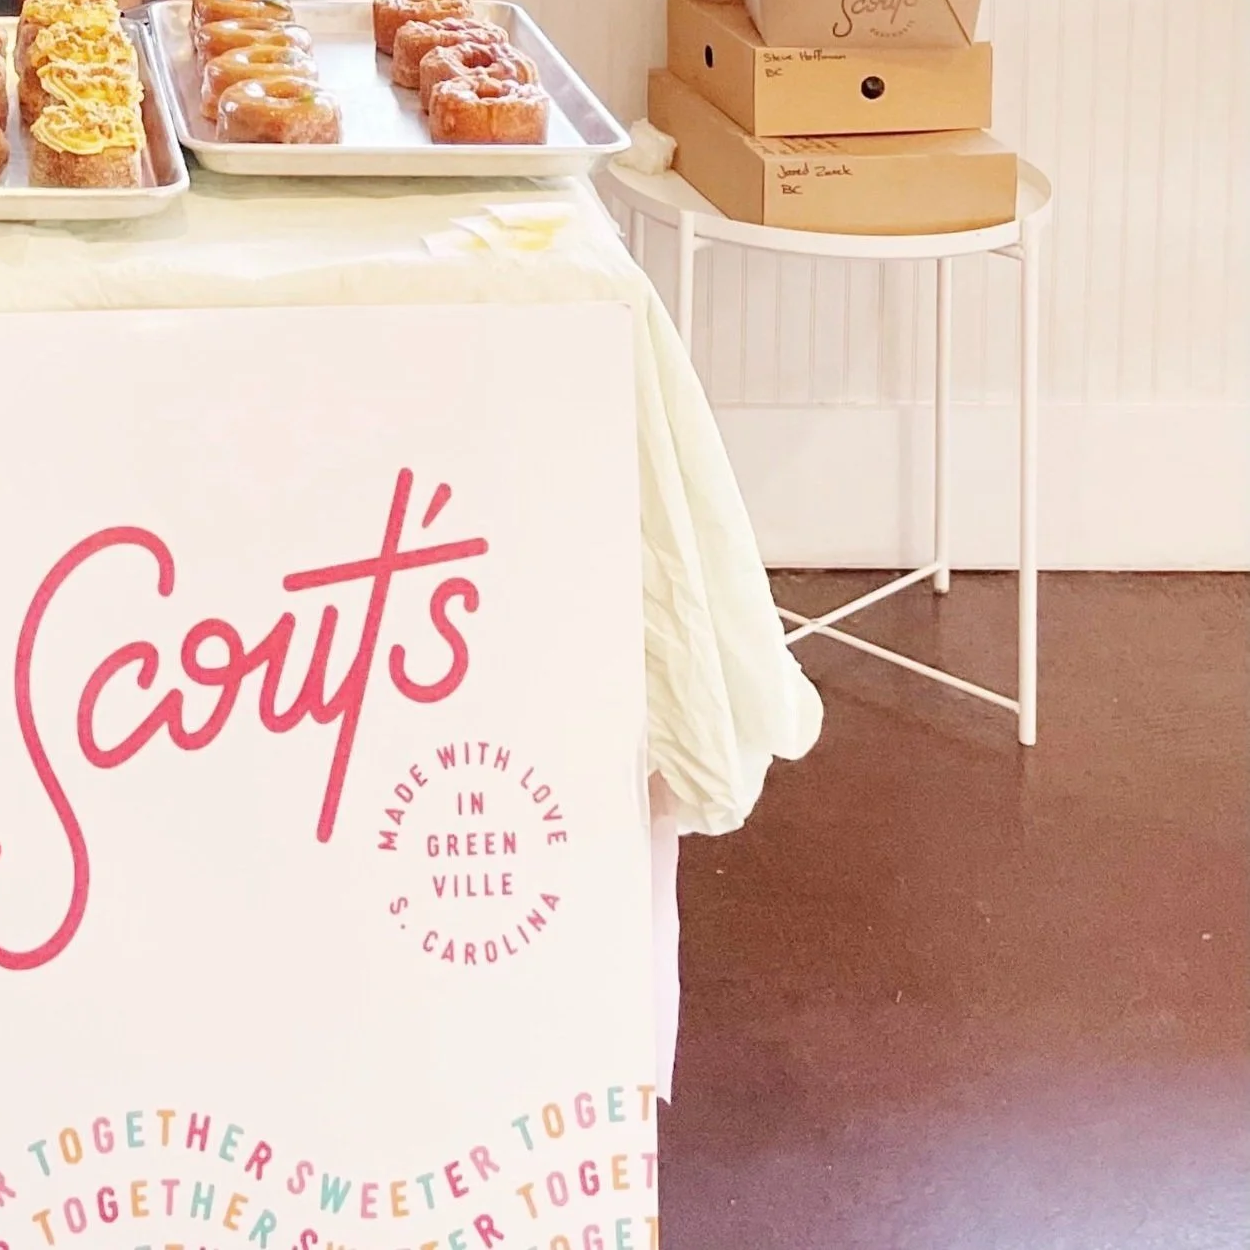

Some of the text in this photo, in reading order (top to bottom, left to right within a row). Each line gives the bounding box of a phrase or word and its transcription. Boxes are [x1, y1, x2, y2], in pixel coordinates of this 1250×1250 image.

[780, 184, 804, 195] BC
[377, 741, 567, 851] MADE WITH LOVE
[457, 792, 485, 815] IN
[426, 831, 517, 857] GREEN
[432, 872, 513, 899] VILLE
[389, 893, 561, 966] S. CAROLINA
[27, 1109, 273, 1181] TOGETHER
[286, 1145, 501, 1219] SWEETER
[510, 1084, 656, 1151] TOGET
[31, 1178, 278, 1250] TOGETHER
[515, 1152, 658, 1219] TOGET
